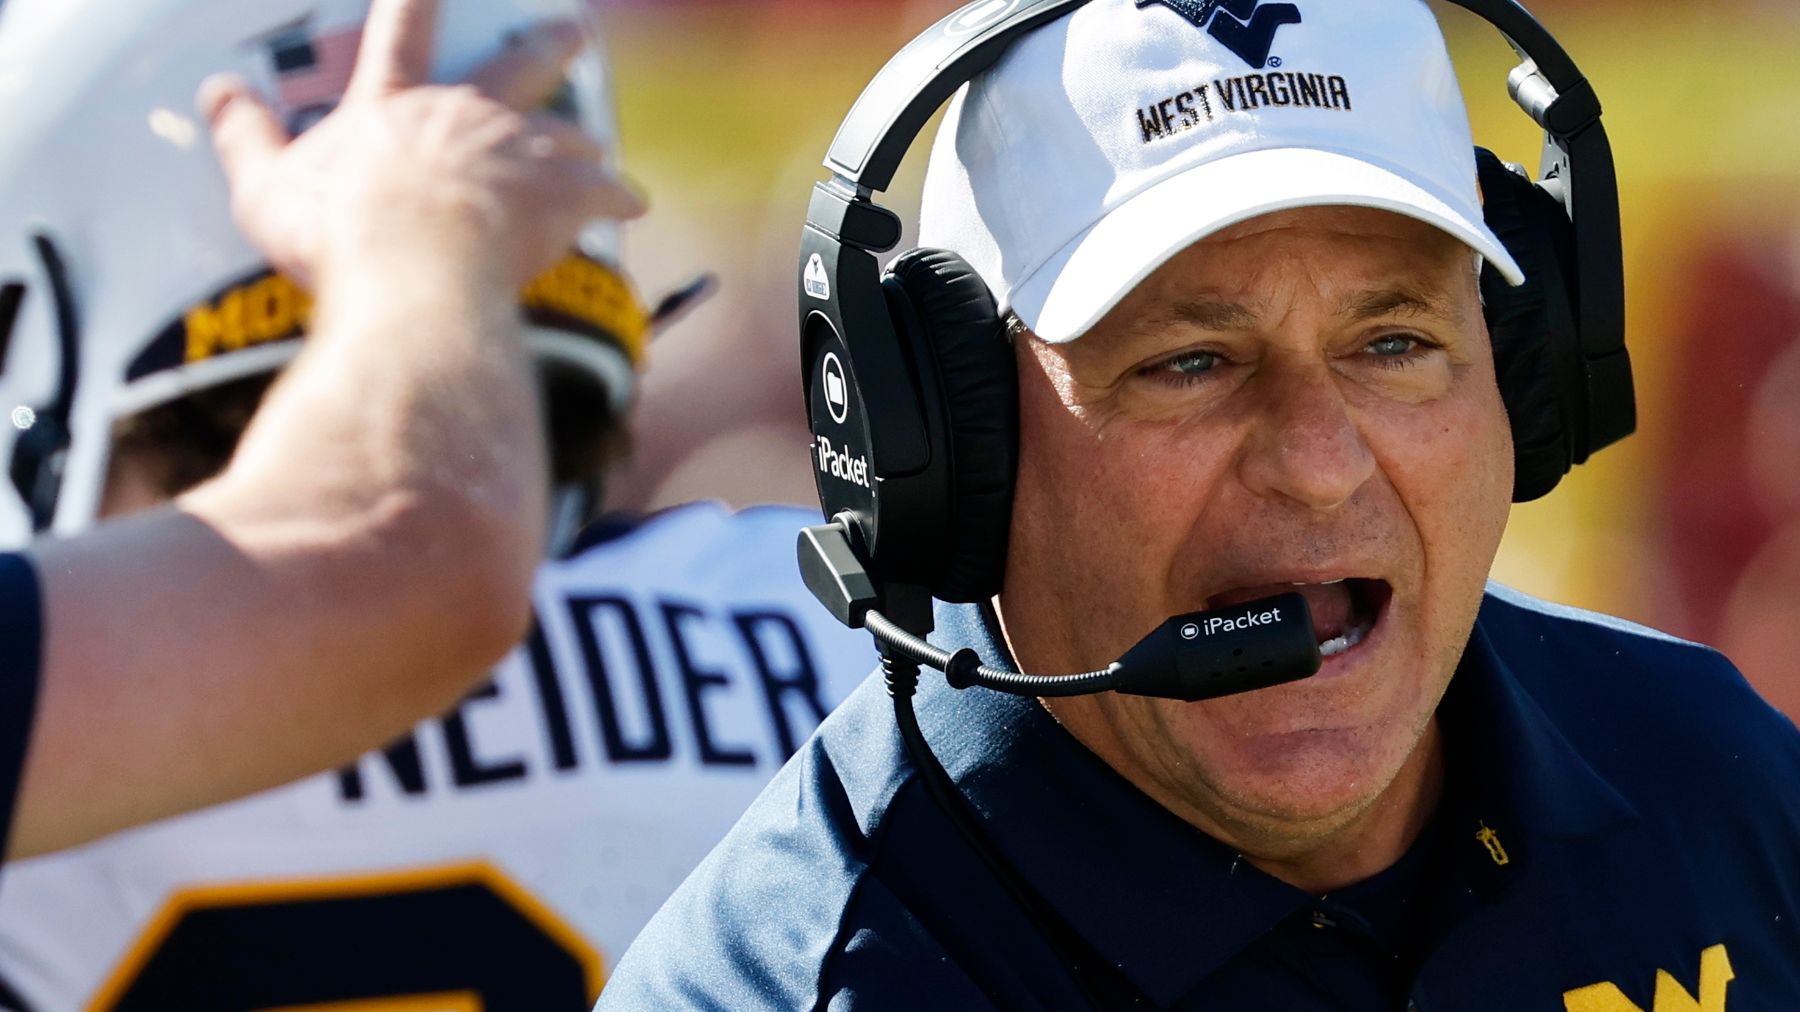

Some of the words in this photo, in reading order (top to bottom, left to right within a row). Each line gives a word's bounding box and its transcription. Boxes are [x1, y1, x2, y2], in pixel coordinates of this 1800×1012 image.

[1136, 83, 1215, 144] WEST
[1213, 71, 1352, 112] VIRGINIA
[816, 435, 870, 488] iPacket
[1203, 607, 1282, 636] iPacket
